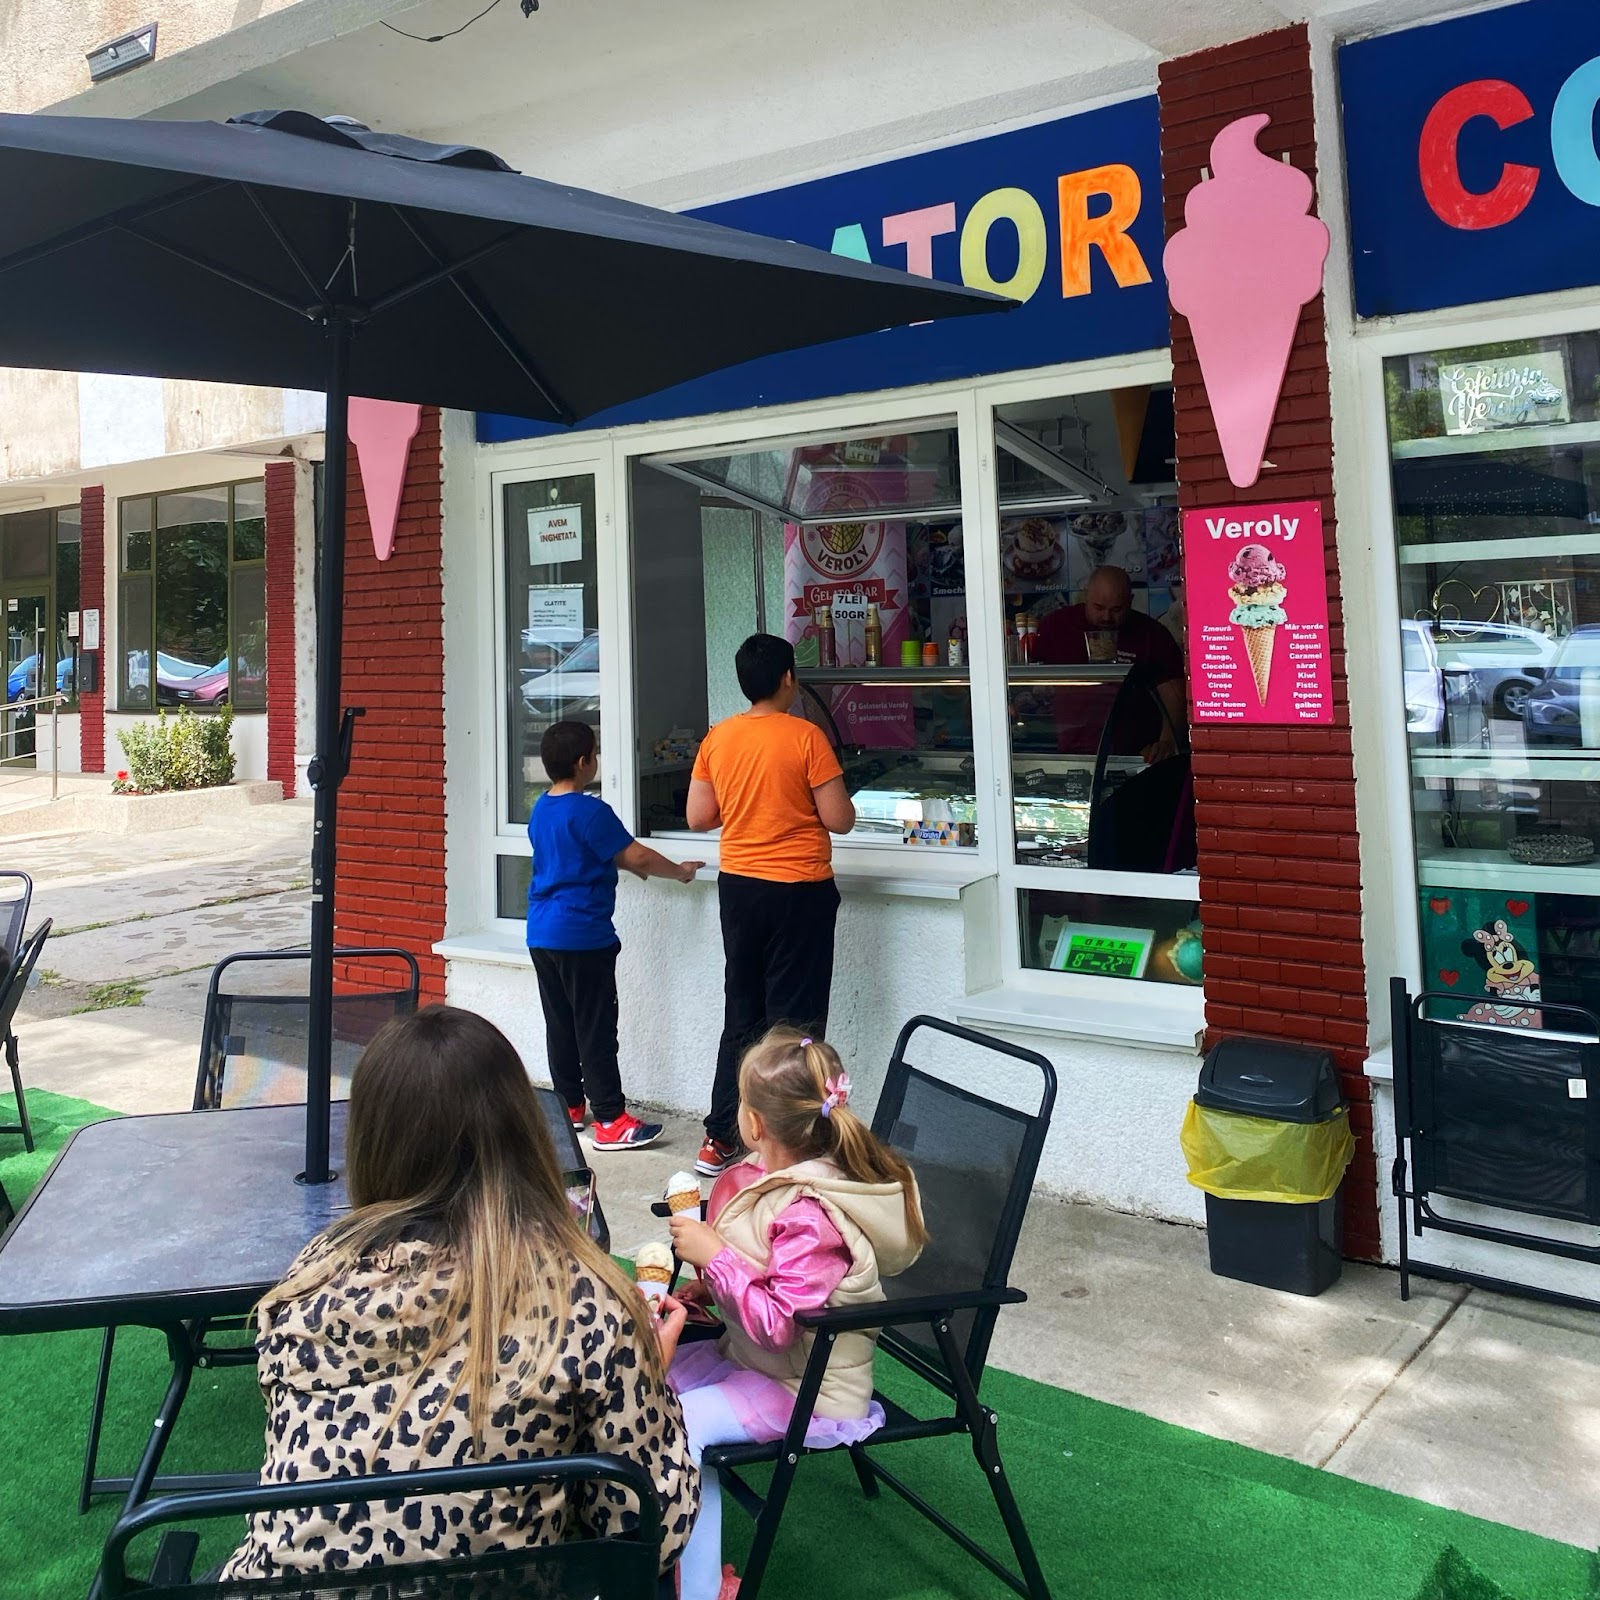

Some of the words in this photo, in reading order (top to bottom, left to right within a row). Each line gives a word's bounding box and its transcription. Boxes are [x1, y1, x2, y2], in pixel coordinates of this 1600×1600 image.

[548, 519, 568, 528] AVEM
[1205, 514, 1299, 541] Veroly
[817, 544, 869, 571] VEROLY
[837, 595, 863, 604] 7LEI
[834, 610, 865, 619] 50GR
[1205, 653, 1233, 661] Mango,
[1293, 691, 1323, 699] Pepene
[1084, 938, 1127, 949] ORAR
